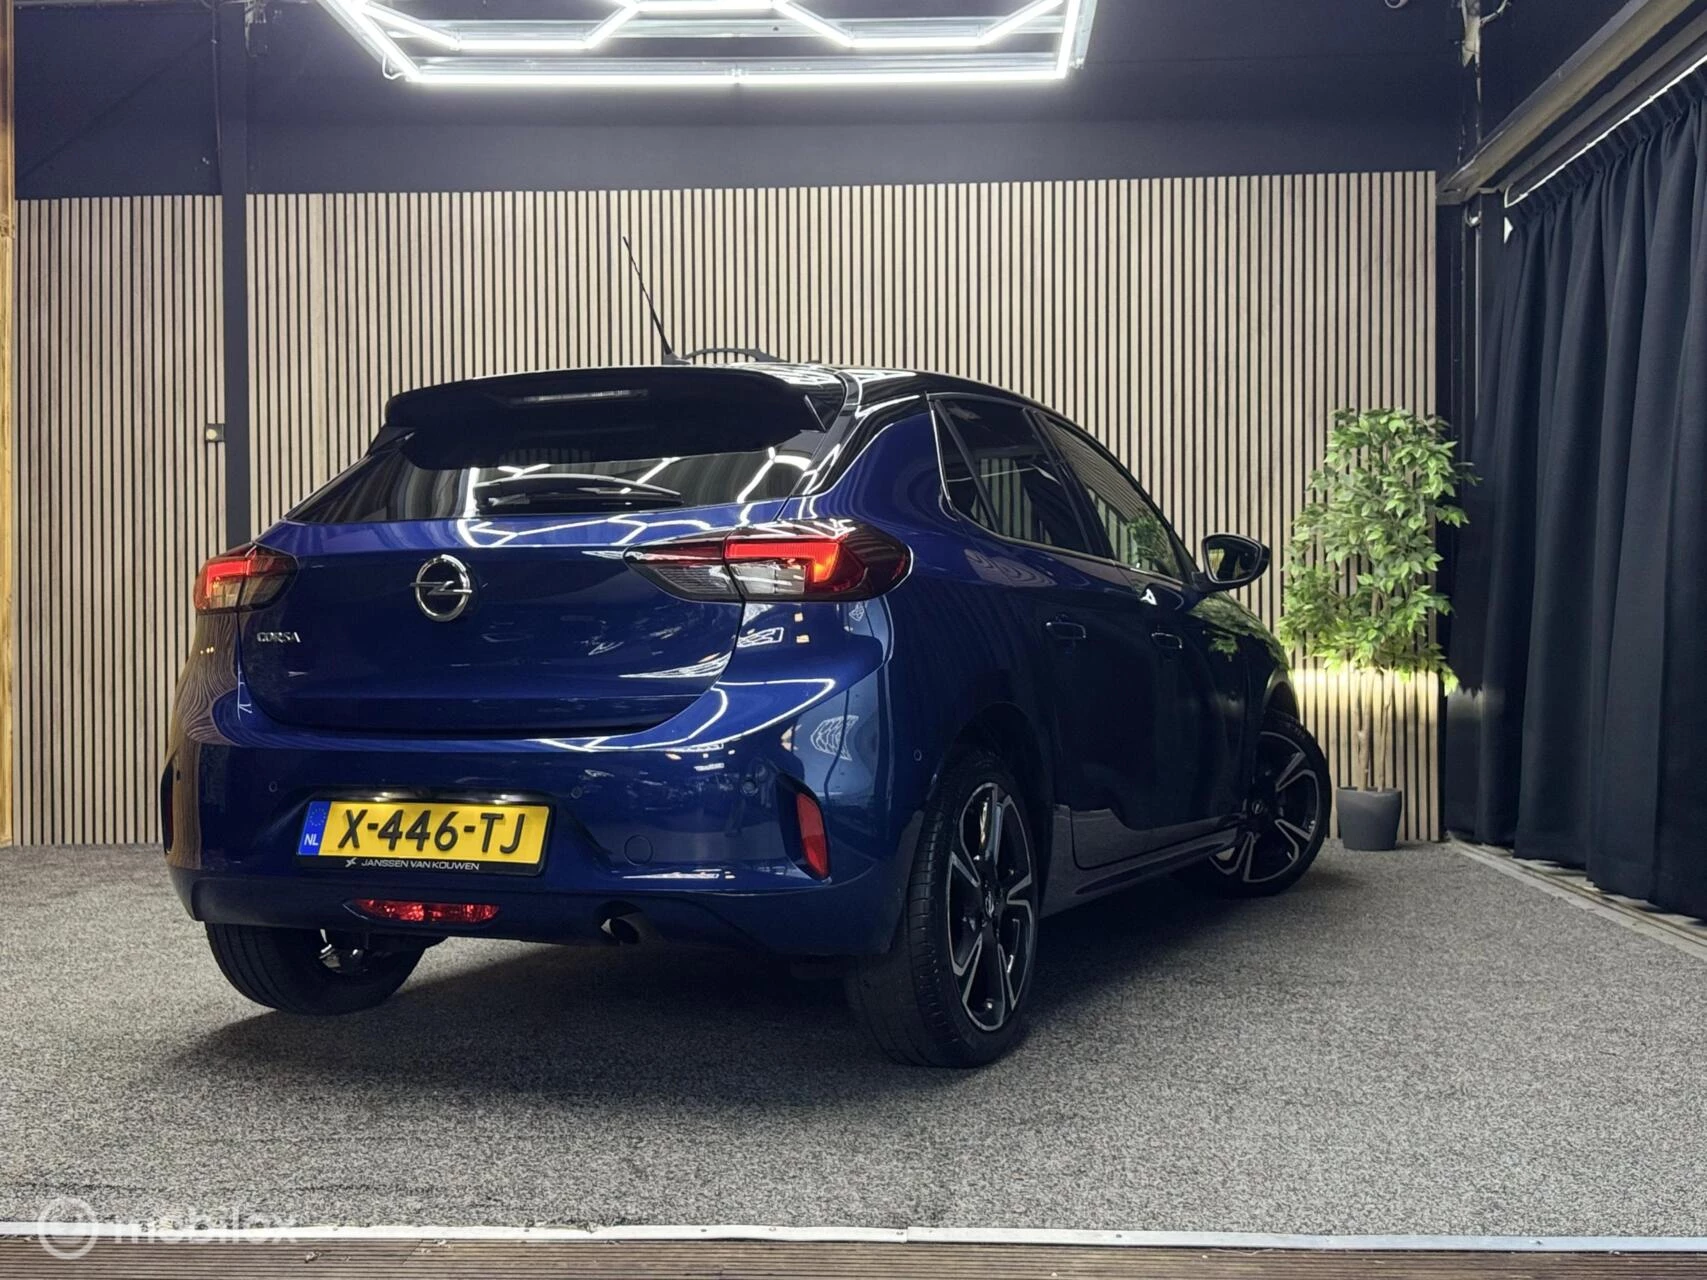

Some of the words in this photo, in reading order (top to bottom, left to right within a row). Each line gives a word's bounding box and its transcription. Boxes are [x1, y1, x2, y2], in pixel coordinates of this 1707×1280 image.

[257, 631, 301, 643] CORSA
[337, 809, 526, 854] X-446-TJ
[304, 833, 319, 846] NL
[361, 859, 409, 868] JANSSEN
[410, 860, 431, 869] VAN
[432, 861, 479, 871] KOUWEN
